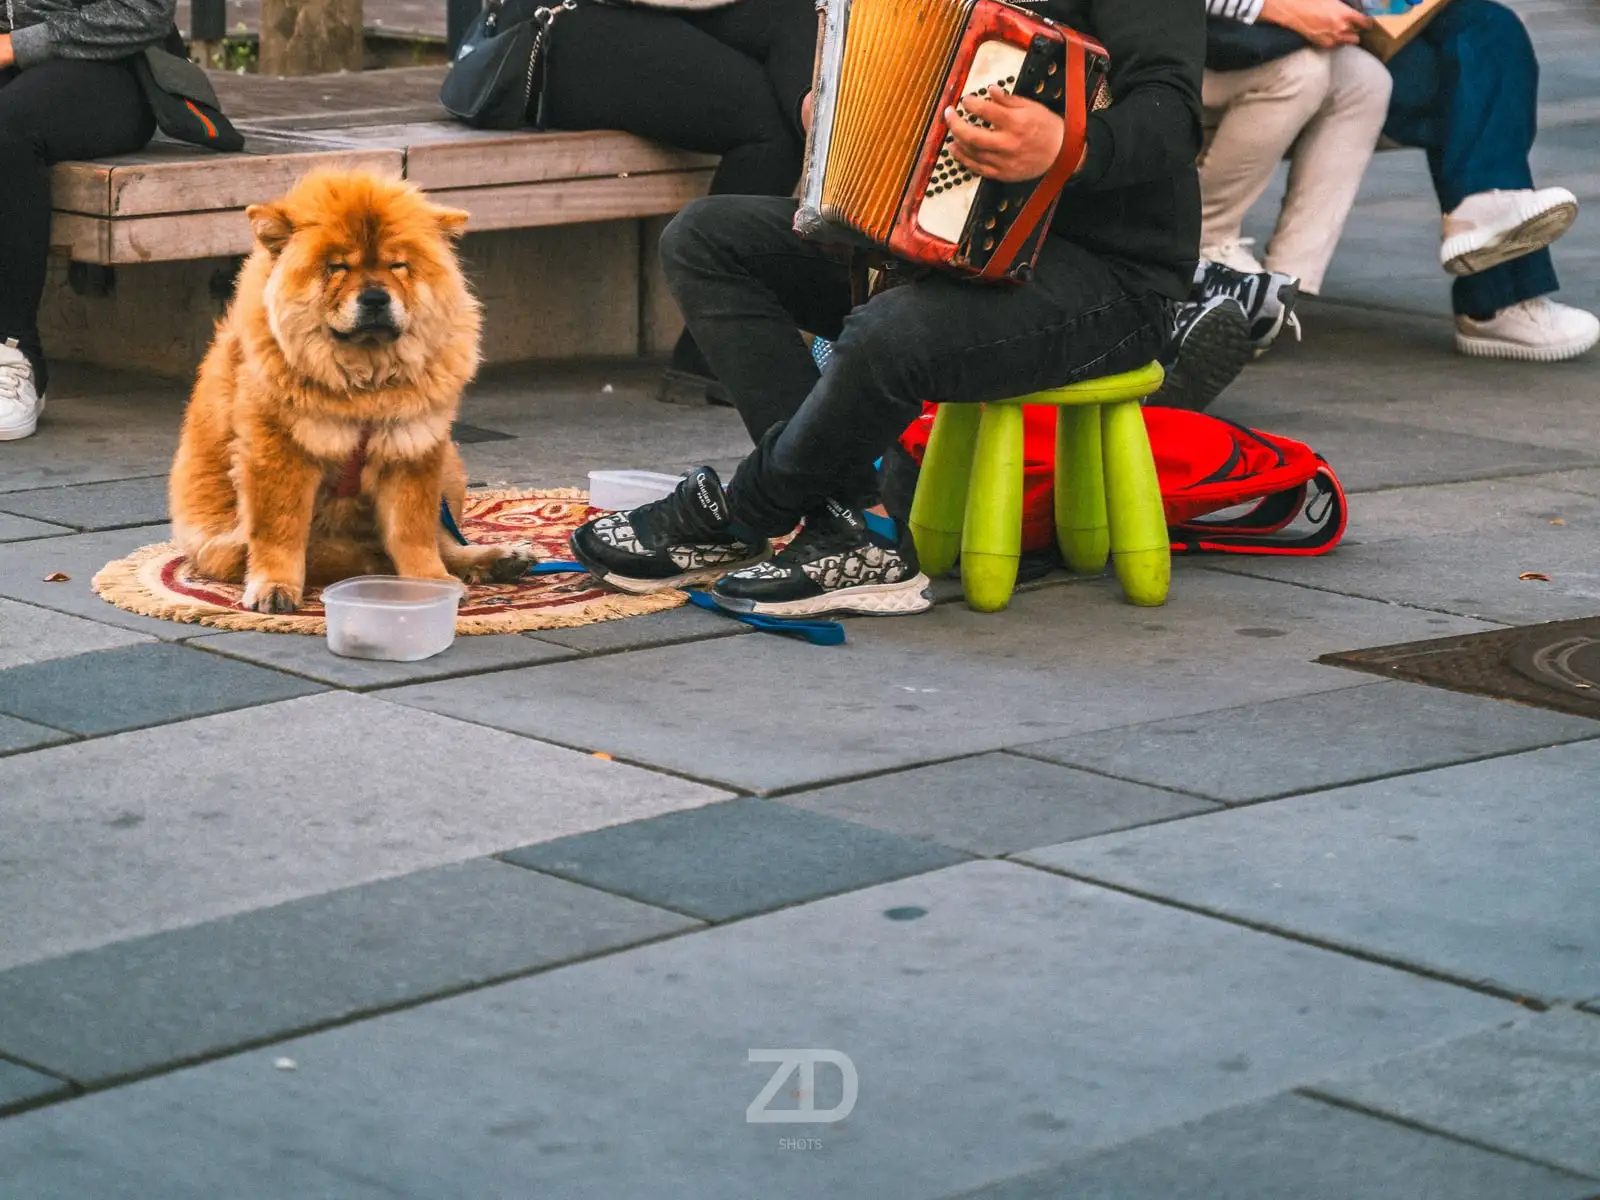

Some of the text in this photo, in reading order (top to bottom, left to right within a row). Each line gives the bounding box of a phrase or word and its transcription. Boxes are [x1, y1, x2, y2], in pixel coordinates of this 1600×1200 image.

[696, 472, 722, 521] Christian Dior
[841, 509, 858, 527] Dior
